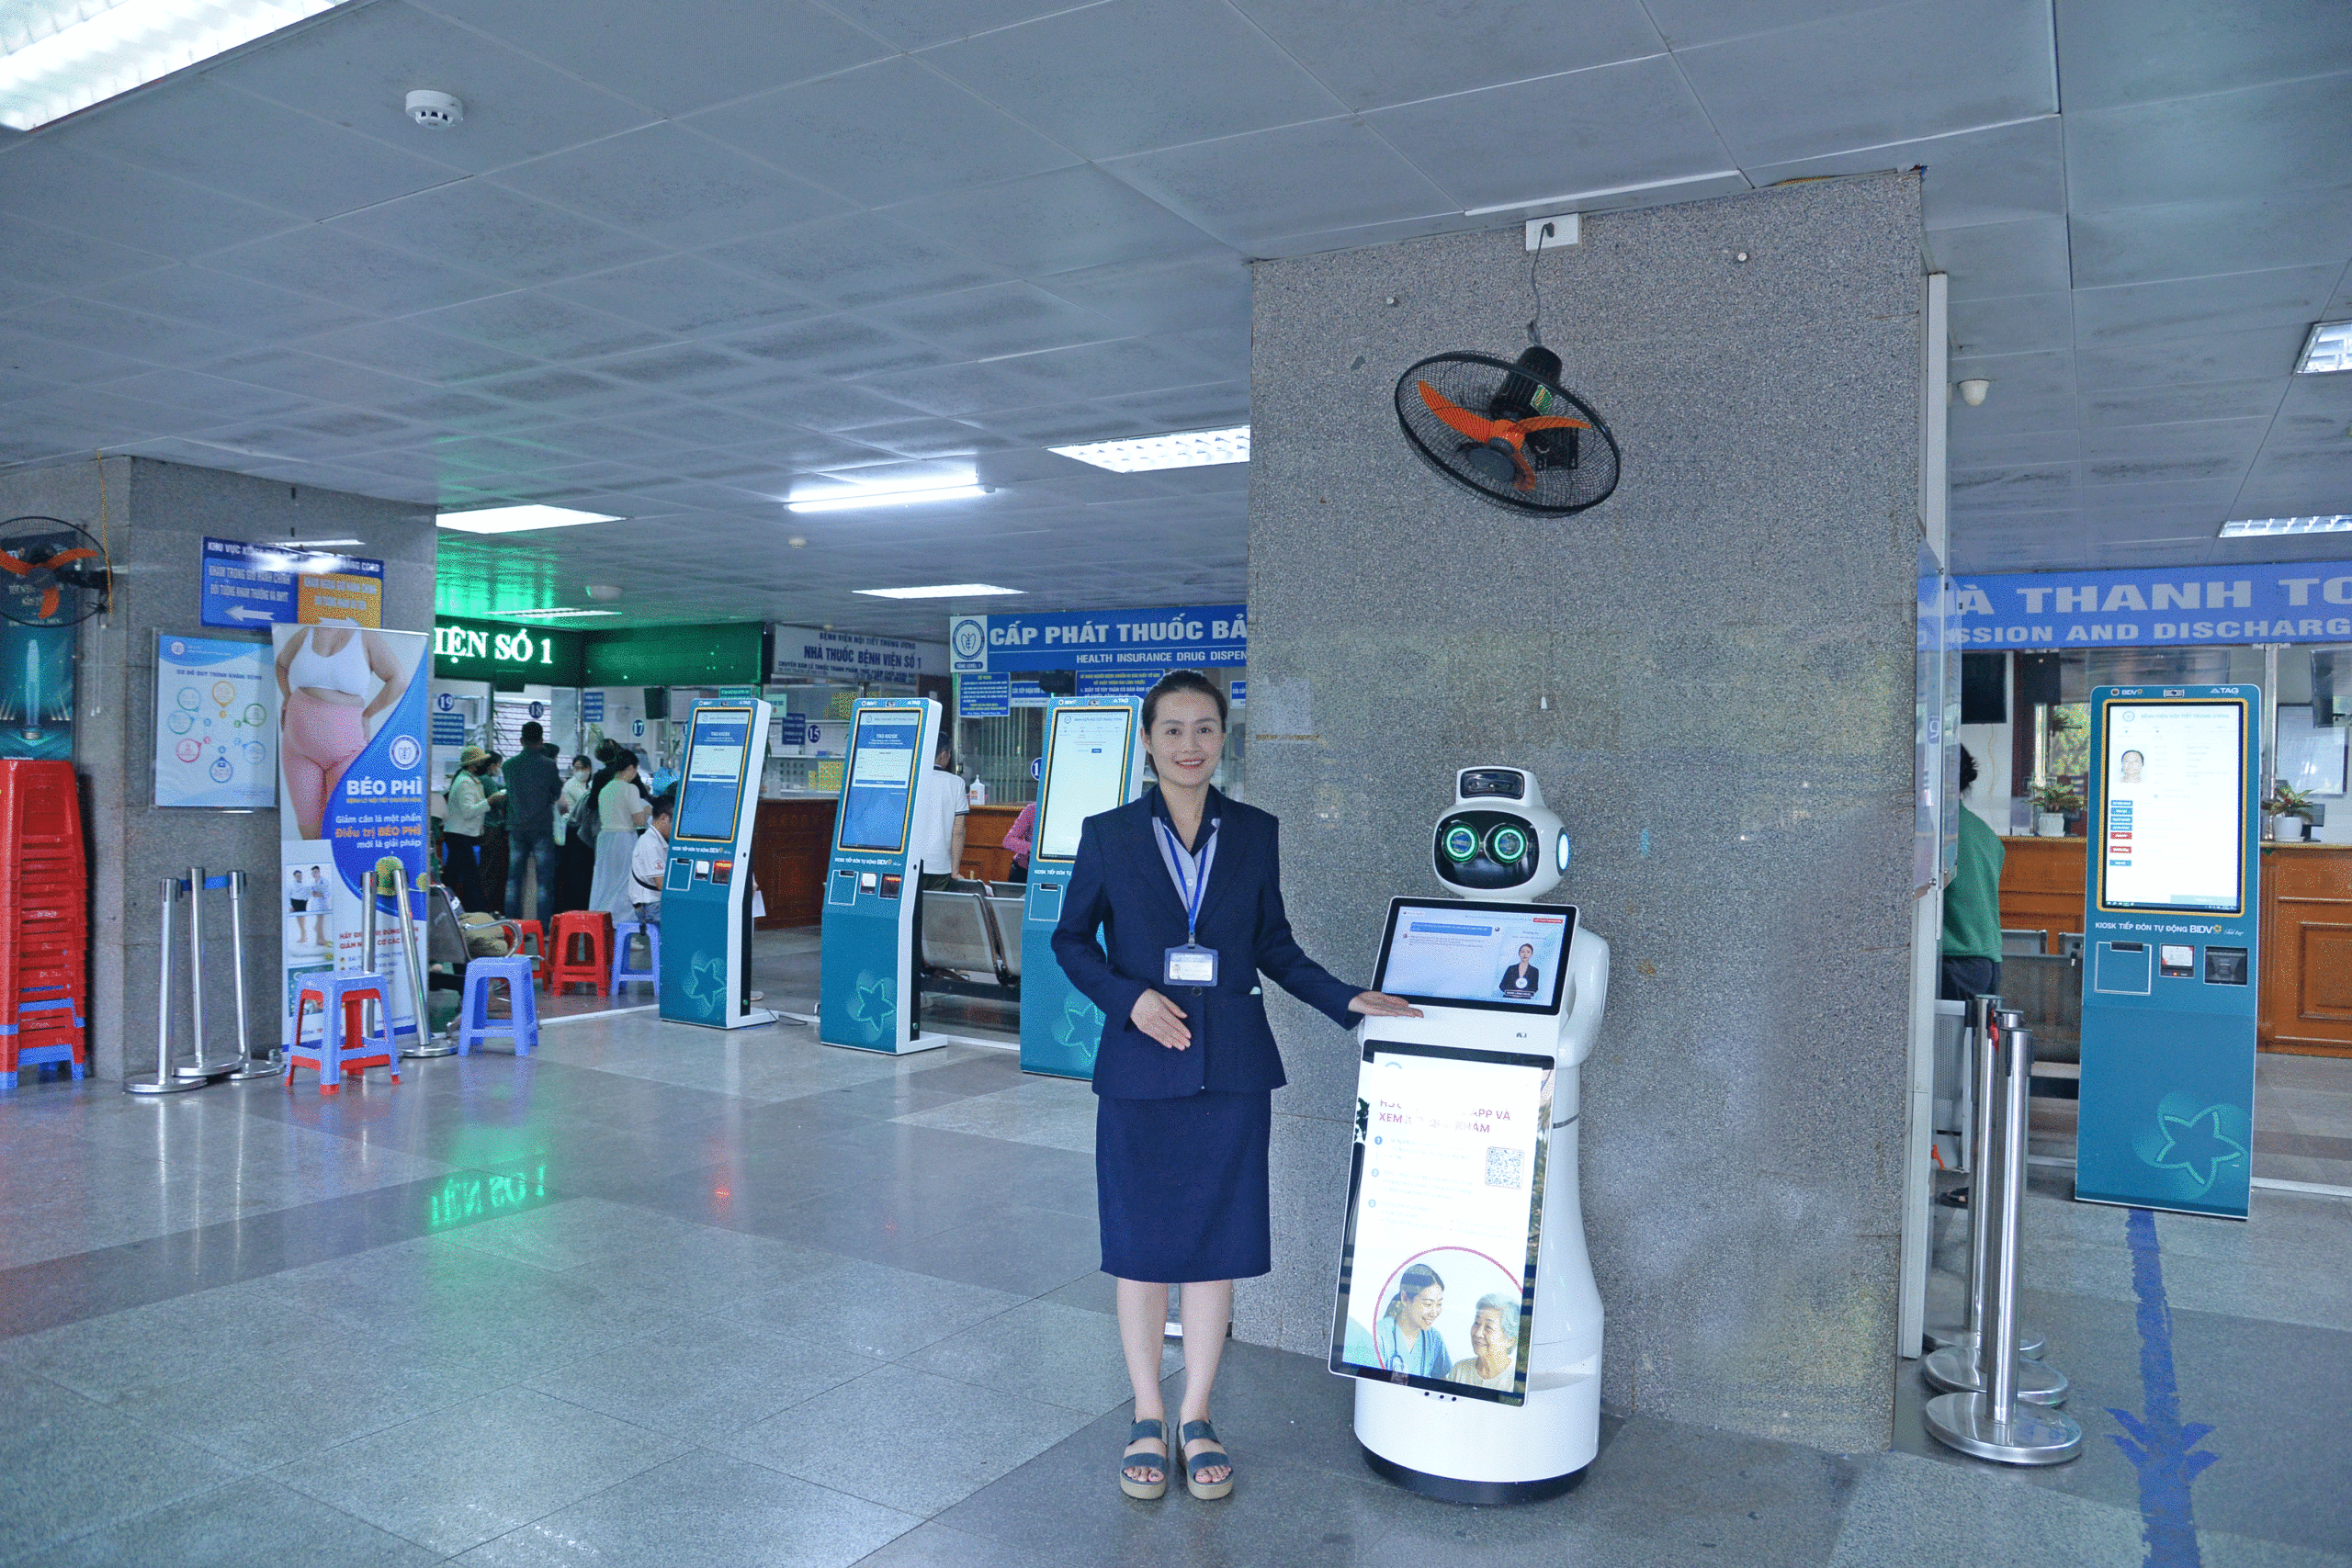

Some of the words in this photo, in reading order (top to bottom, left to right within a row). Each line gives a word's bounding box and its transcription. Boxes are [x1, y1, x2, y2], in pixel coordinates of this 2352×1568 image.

[2017, 580, 2252, 614] THANH
[2278, 576, 2352, 607] TO
[990, 620, 1039, 647] CẤP
[1045, 620, 1109, 645] PHÁT
[1116, 613, 1204, 642] THUỐC
[1212, 613, 1247, 640] BẢ
[2066, 624, 2140, 642] AND
[2154, 617, 2352, 640] DISCHARG
[433, 625, 490, 665] IỆN
[494, 628, 534, 662] SỐ
[540, 637, 553, 664] 1
[819, 632, 837, 643] BỆNH
[838, 633, 853, 644] VIỆN
[804, 643, 823, 660] NHÀ
[825, 645, 854, 663] THUỐC
[857, 649, 881, 667] BỆNH
[883, 651, 902, 670] VIỆN
[904, 651, 916, 670] SỐ
[917, 657, 922, 670] 1
[1076, 654, 1113, 665] HEALTH
[1116, 652, 1172, 664] INSURANCE
[1176, 651, 1205, 662] DRUG
[1210, 649, 1247, 661] DISPEN
[439, 695, 453, 710] 19
[530, 703, 543, 716] 18
[633, 721, 644, 735] 17
[809, 728, 820, 740] 15
[346, 775, 387, 795] BÉO
[390, 775, 423, 795] PHÌ
[335, 814, 357, 824] Giảm
[375, 814, 383, 823] là
[383, 813, 400, 824] một
[334, 826, 360, 839] Điều
[362, 827, 376, 840] trị
[378, 824, 401, 837] BÉO
[401, 822, 423, 837] PHÌ
[375, 839, 383, 848] là
[400, 837, 423, 849] pháp
[2095, 921, 2117, 931] KIOSK
[2118, 920, 2135, 931] TIẾP
[2135, 922, 2153, 932] ĐÓN
[2154, 924, 2165, 933] TỰ
[2165, 924, 2188, 934] ĐỘNG
[2189, 925, 2214, 935] BIDV
[1378, 1111, 1403, 1123] XEM
